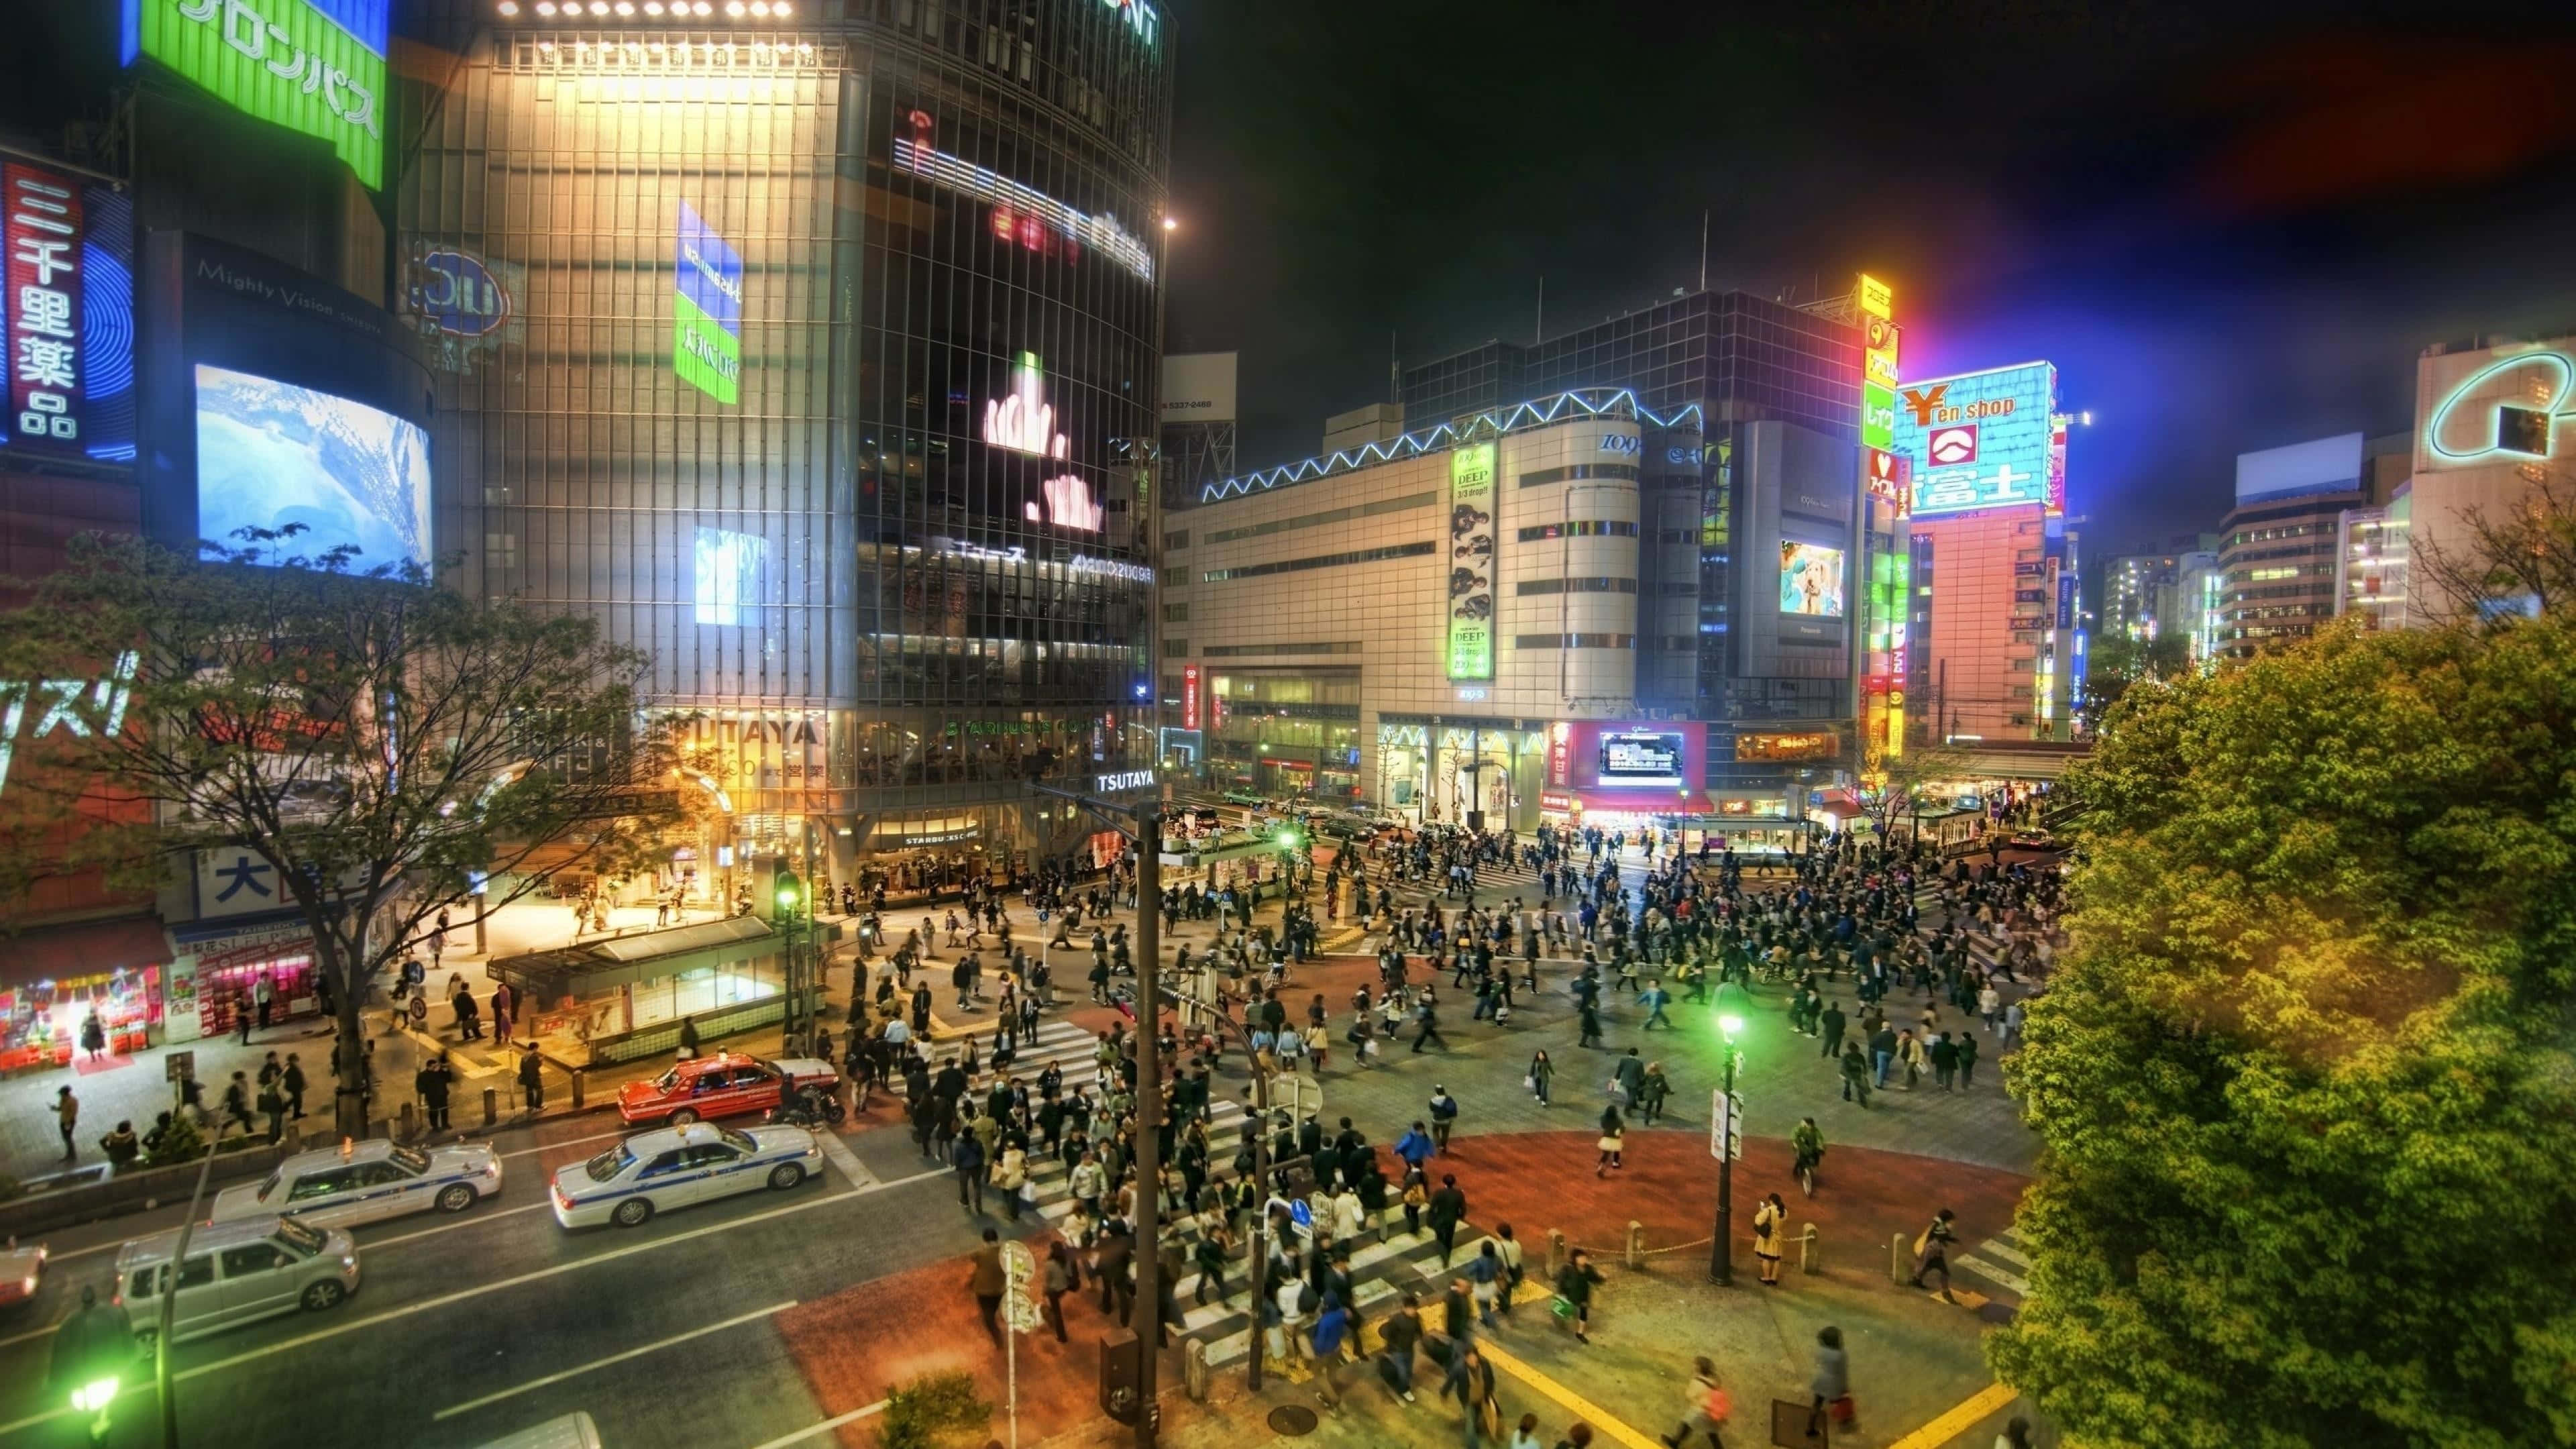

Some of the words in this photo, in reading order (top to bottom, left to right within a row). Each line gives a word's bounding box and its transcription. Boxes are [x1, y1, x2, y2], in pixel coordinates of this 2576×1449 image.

[198, 258, 274, 297] Mighty
[280, 286, 333, 315] Vision
[15, 179, 76, 440] 三千里薬品
[1965, 398, 2016, 420] shop
[1600, 434, 1639, 457] 109
[1458, 471, 1488, 484] DEEP
[1455, 632, 1485, 642] DEEP
[678, 719, 818, 745] UTAYA
[1098, 771, 1154, 792] TSUTAYA
